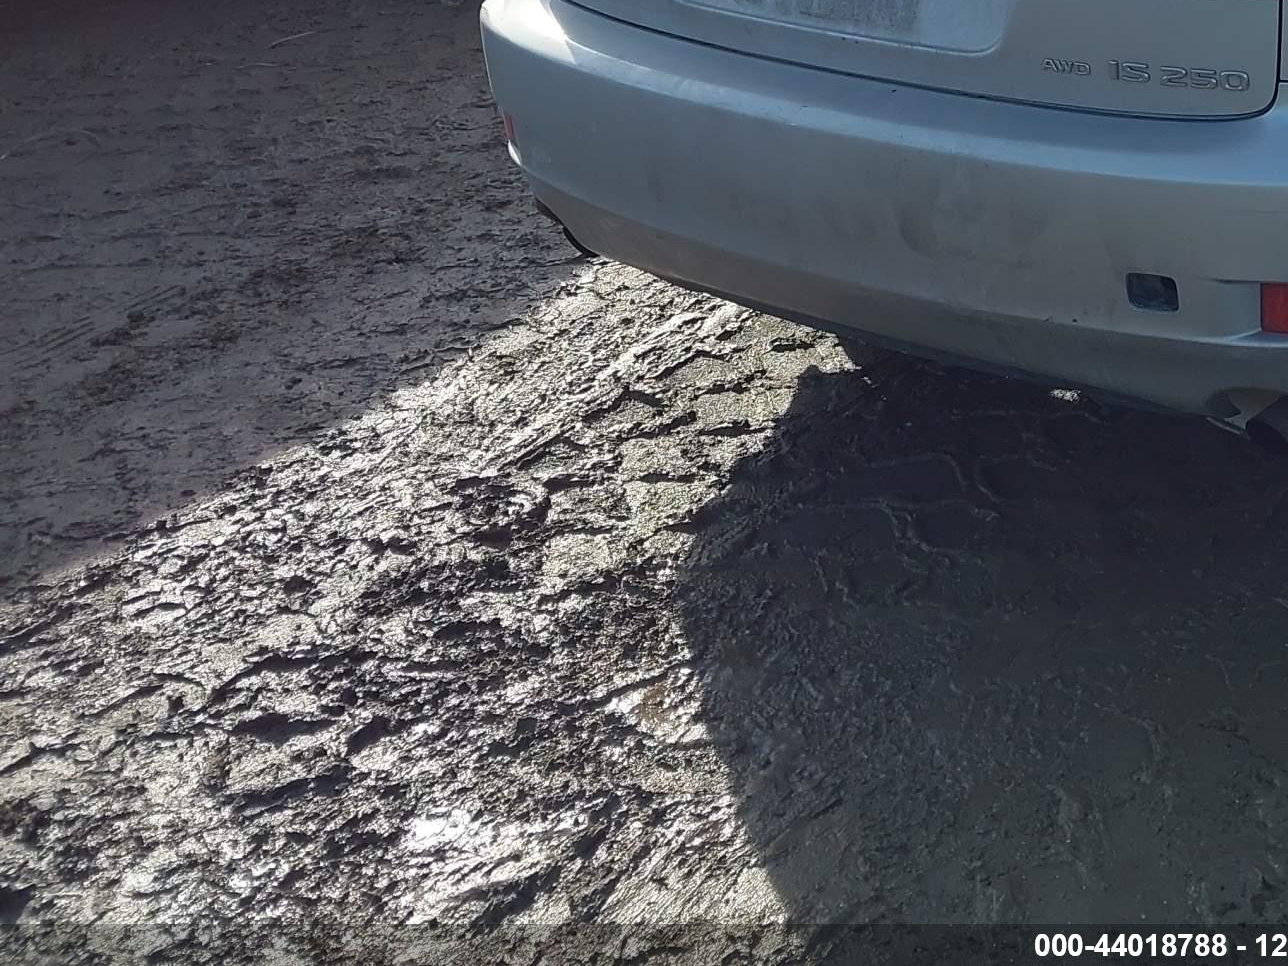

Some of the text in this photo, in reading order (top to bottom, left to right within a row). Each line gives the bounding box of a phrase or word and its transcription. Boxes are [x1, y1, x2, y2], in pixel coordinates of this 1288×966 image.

[1042, 57, 1250, 92] AWD IS 250
